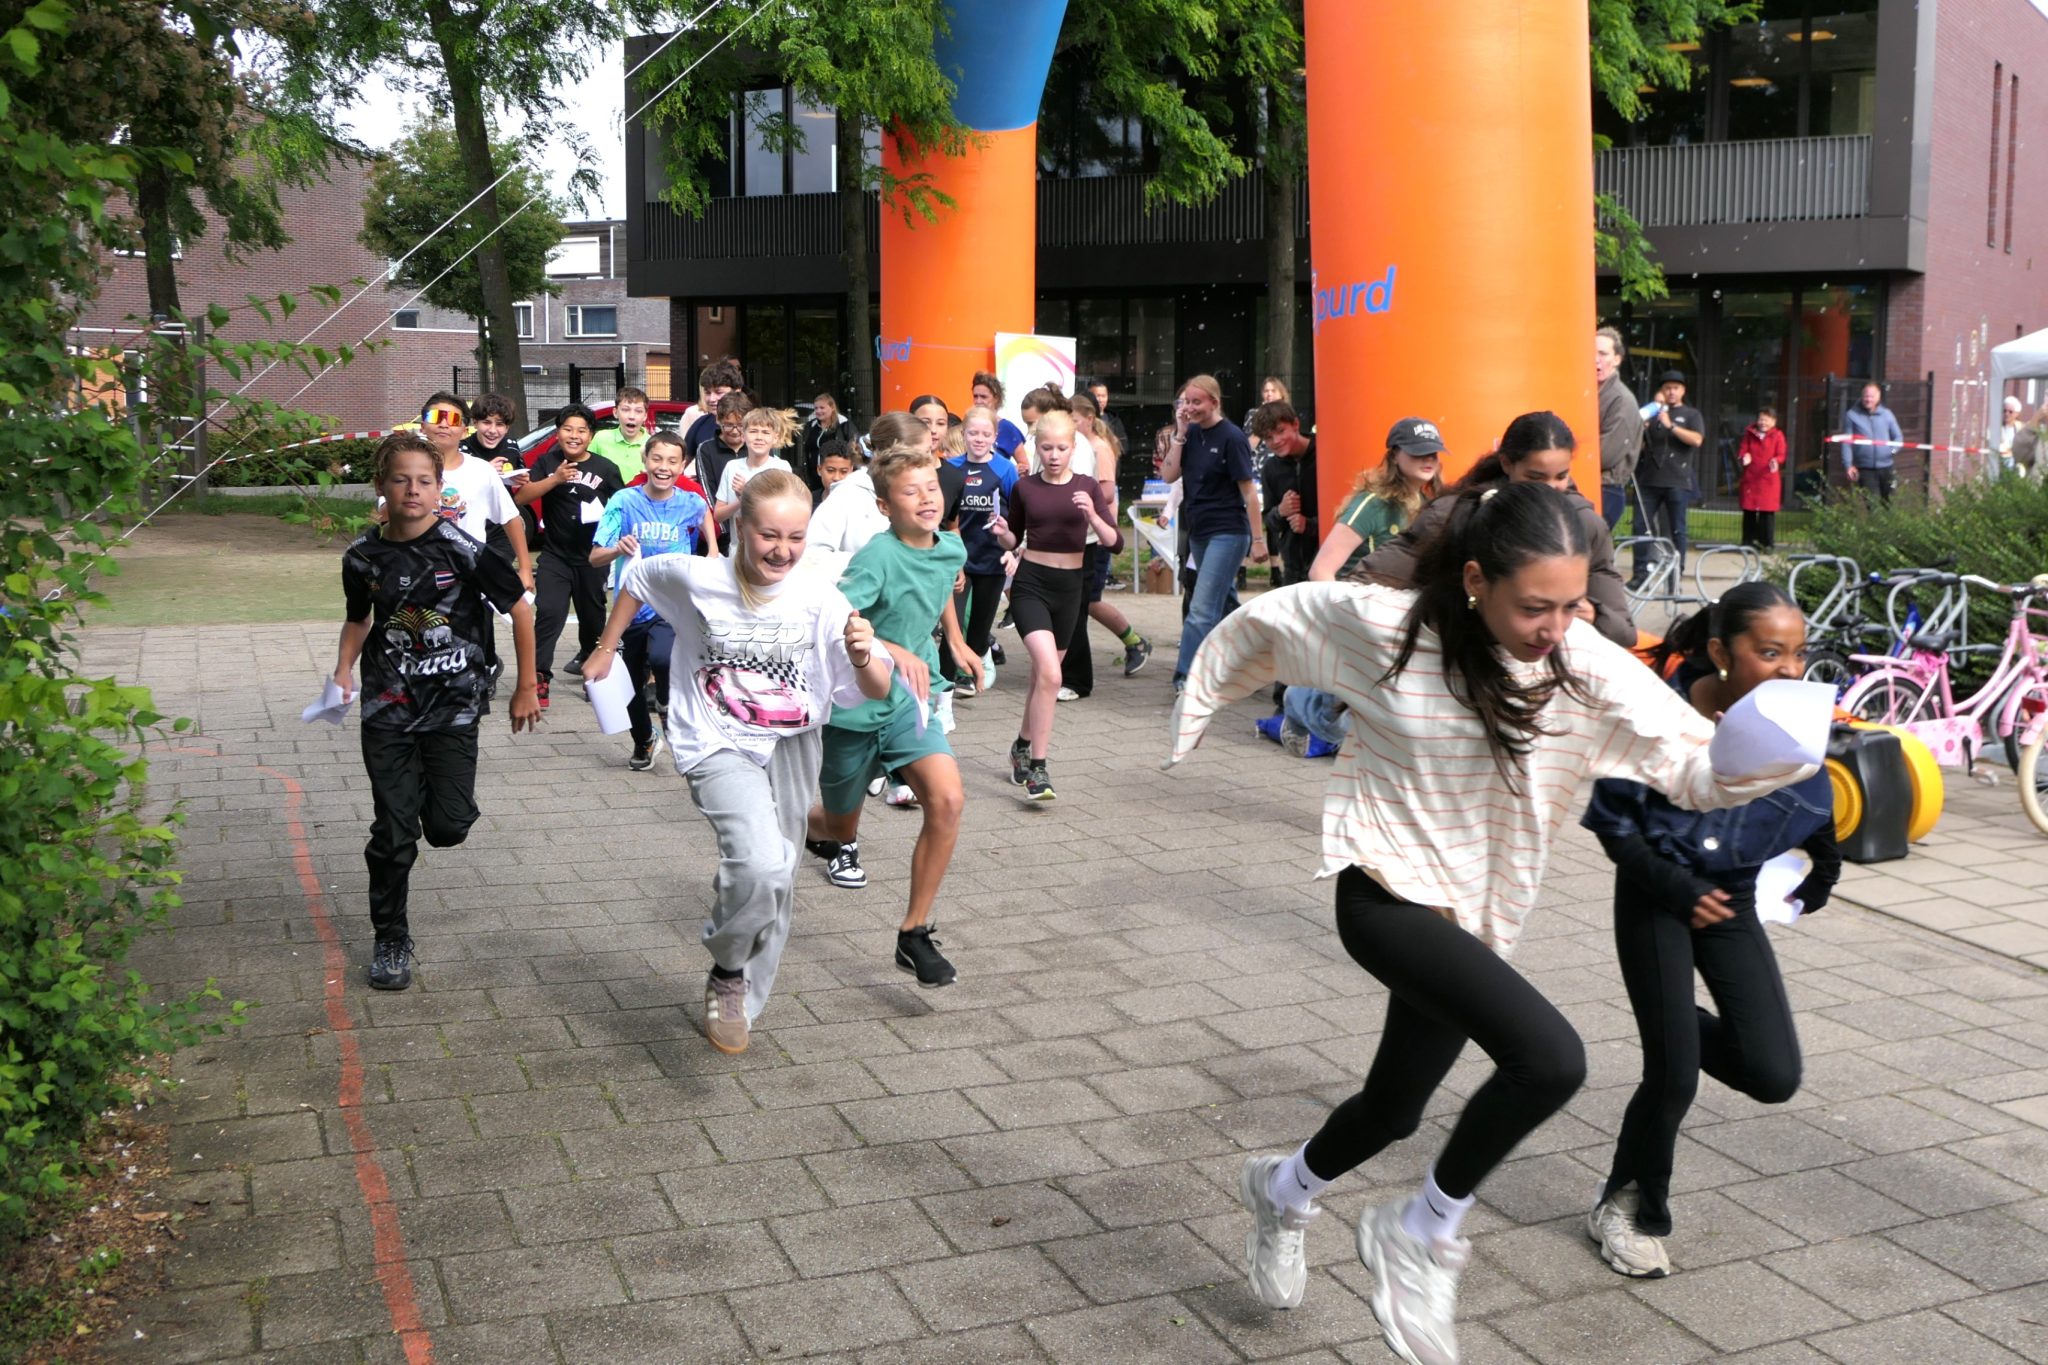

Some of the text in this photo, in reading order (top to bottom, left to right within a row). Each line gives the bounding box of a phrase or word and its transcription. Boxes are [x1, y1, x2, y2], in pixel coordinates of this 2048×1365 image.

[965, 494, 1000, 507] GROU
[442, 529, 478, 553] Kubota
[632, 521, 680, 543] ARUBA
[715, 641, 816, 666] LIMIT
